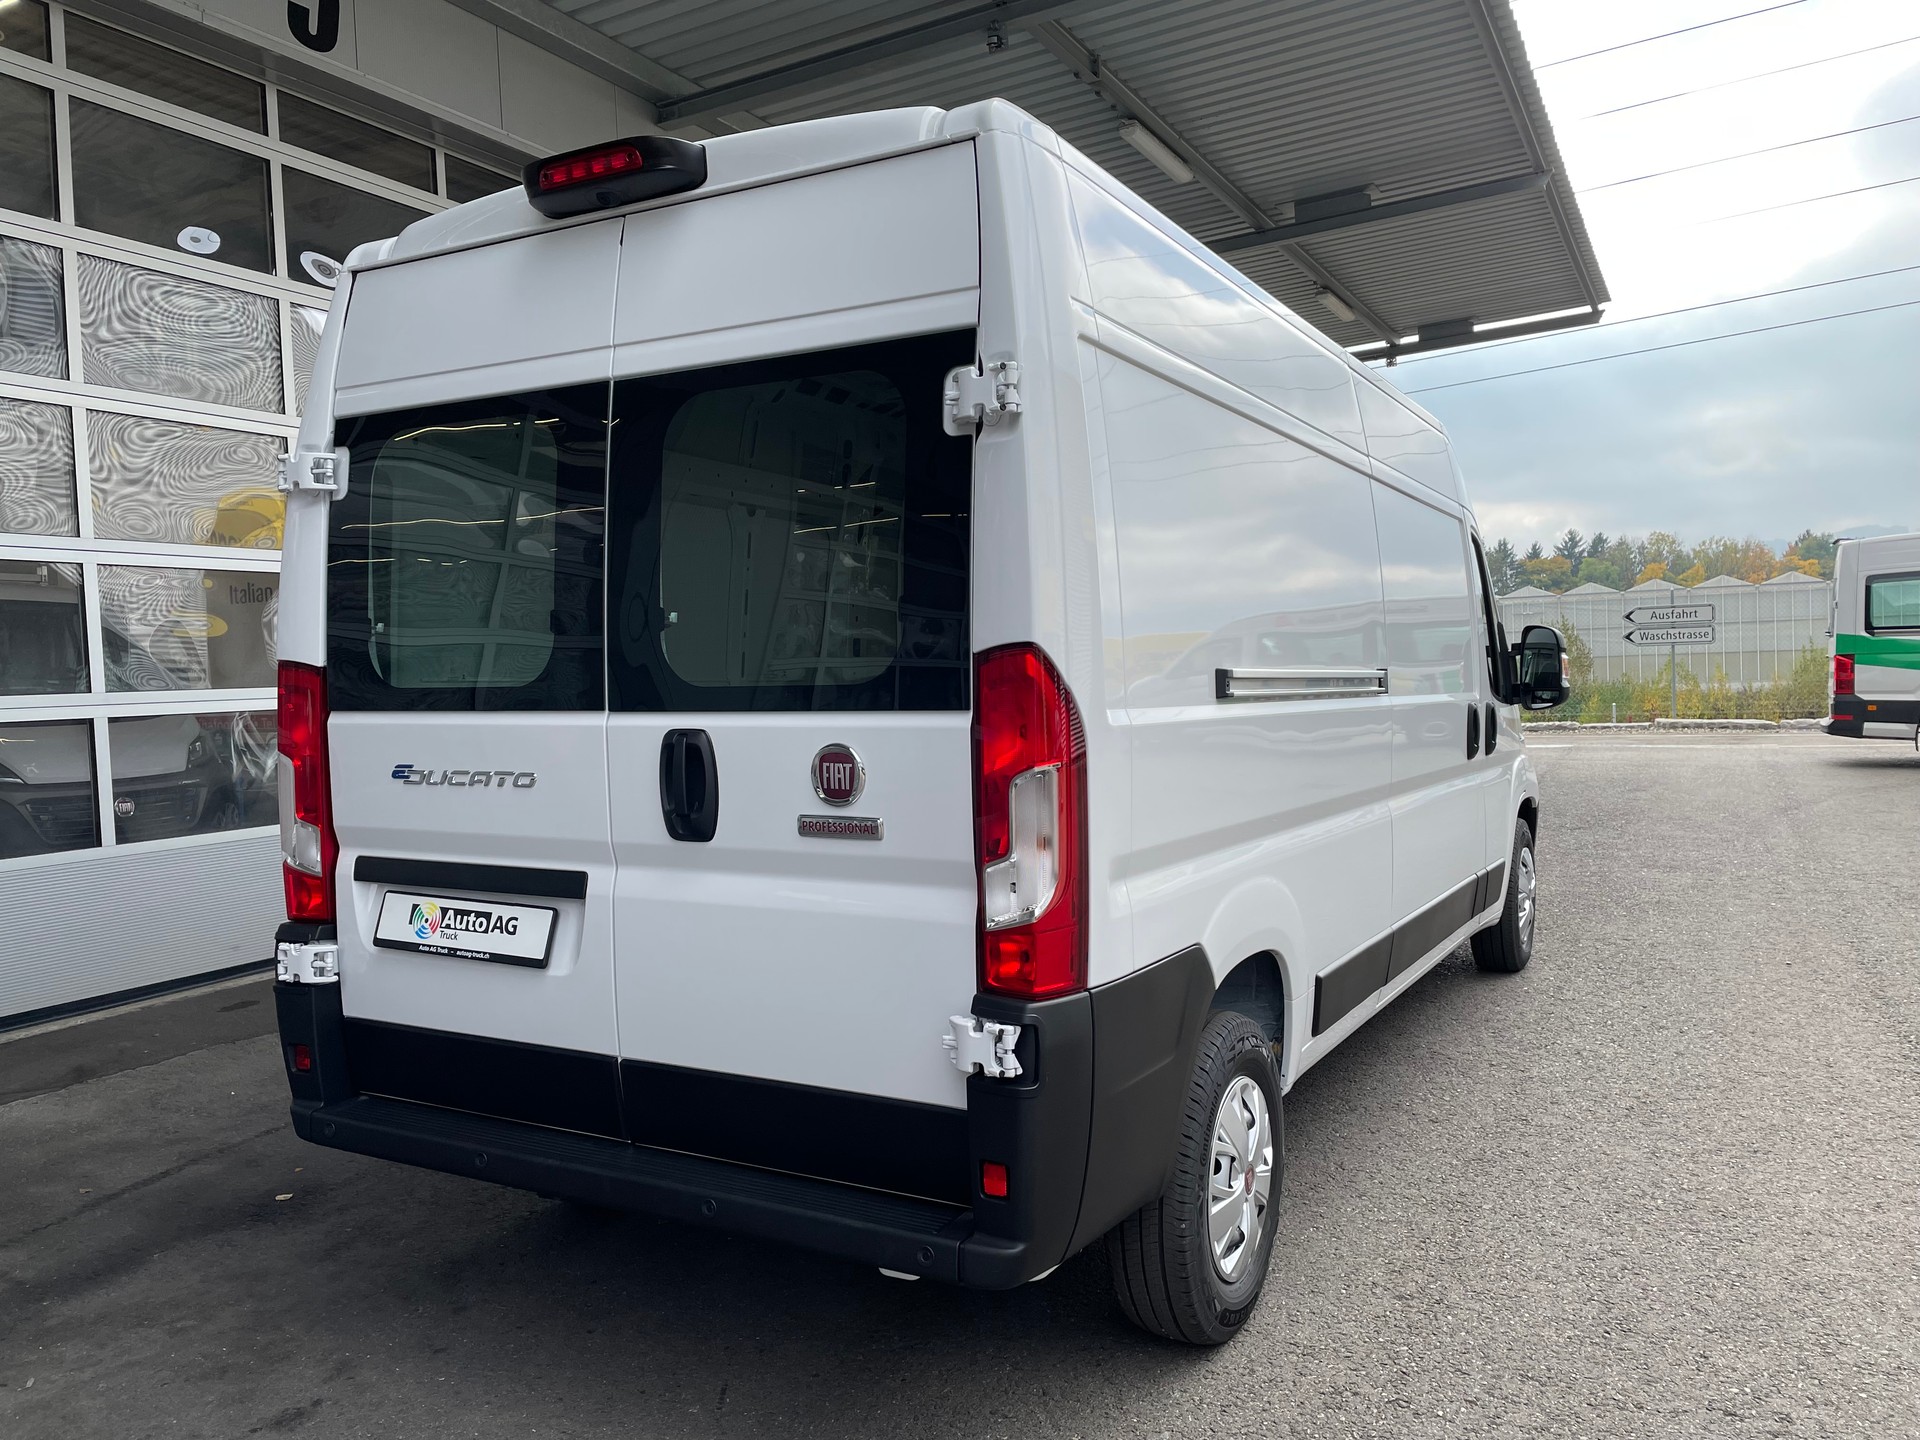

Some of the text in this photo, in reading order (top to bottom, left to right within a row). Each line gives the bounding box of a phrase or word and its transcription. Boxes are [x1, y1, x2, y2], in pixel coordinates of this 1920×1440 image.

[1650, 609, 1698, 620] Ausfahrt
[1639, 630, 1710, 641] Waschstrasse
[822, 762, 853, 790] FIAT
[118, 802, 131, 813] FIAT
[802, 820, 876, 835] PROFESSIONAL
[441, 909, 519, 936] Auto AG
[439, 930, 459, 941] Truck
[456, 949, 490, 959] autoag-truck.ch
[1199, 1089, 1220, 1168] Continental
